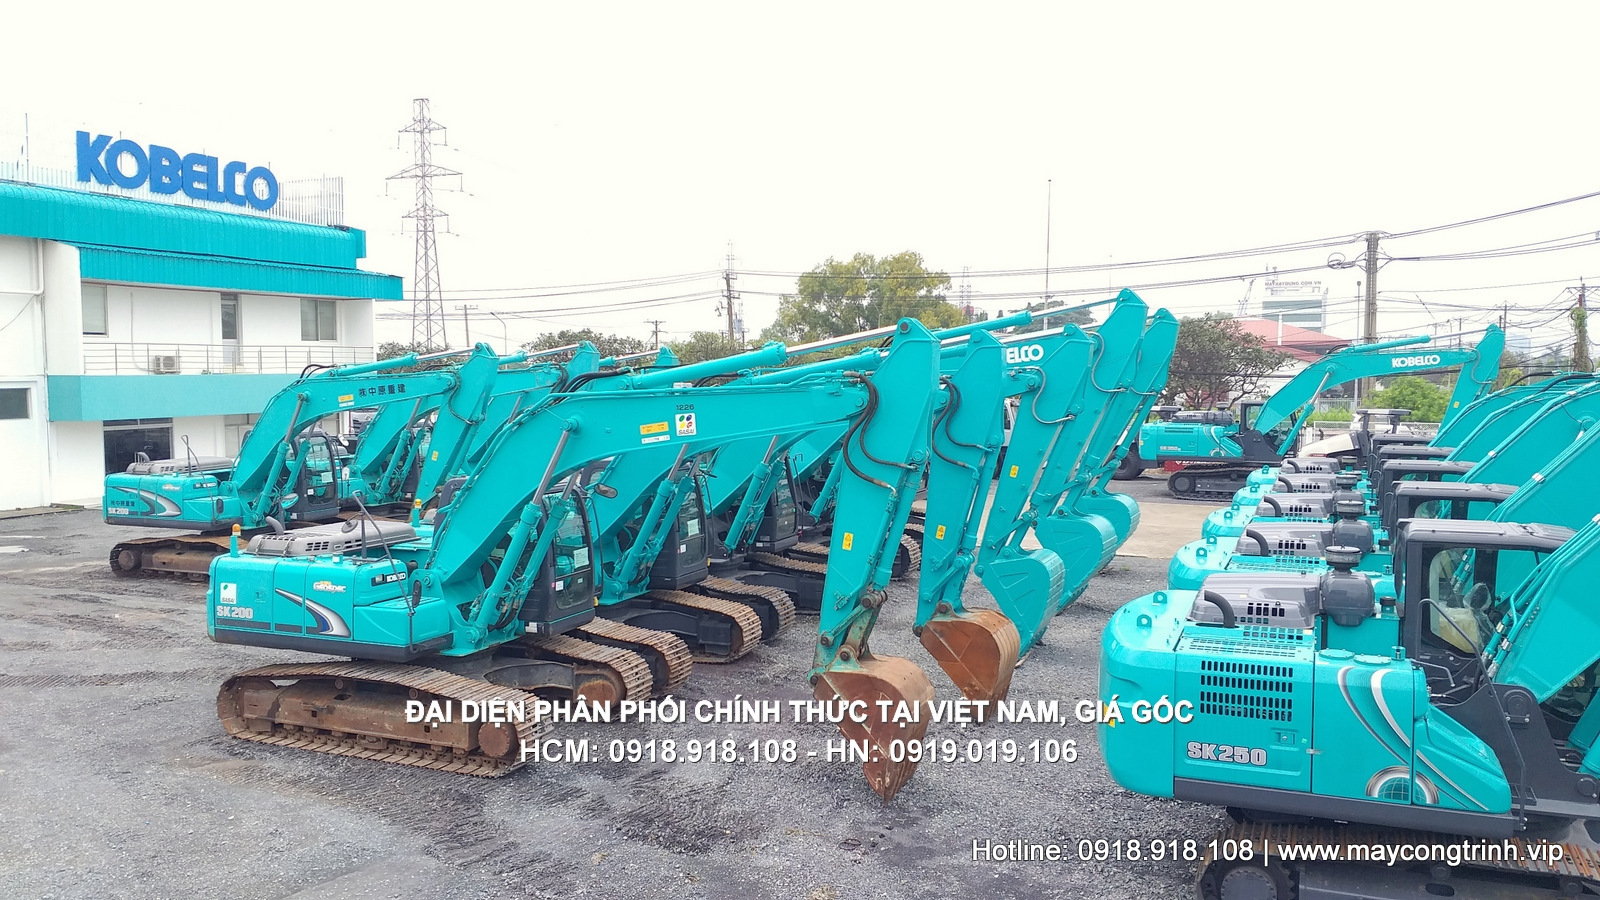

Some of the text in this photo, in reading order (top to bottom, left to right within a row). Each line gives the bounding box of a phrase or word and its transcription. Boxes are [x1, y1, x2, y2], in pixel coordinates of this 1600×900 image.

[76, 130, 279, 211] KOBELCO
[1006, 344, 1045, 364] ELCO
[1391, 354, 1441, 368] KOBELCO
[1187, 741, 1267, 766] SK250
